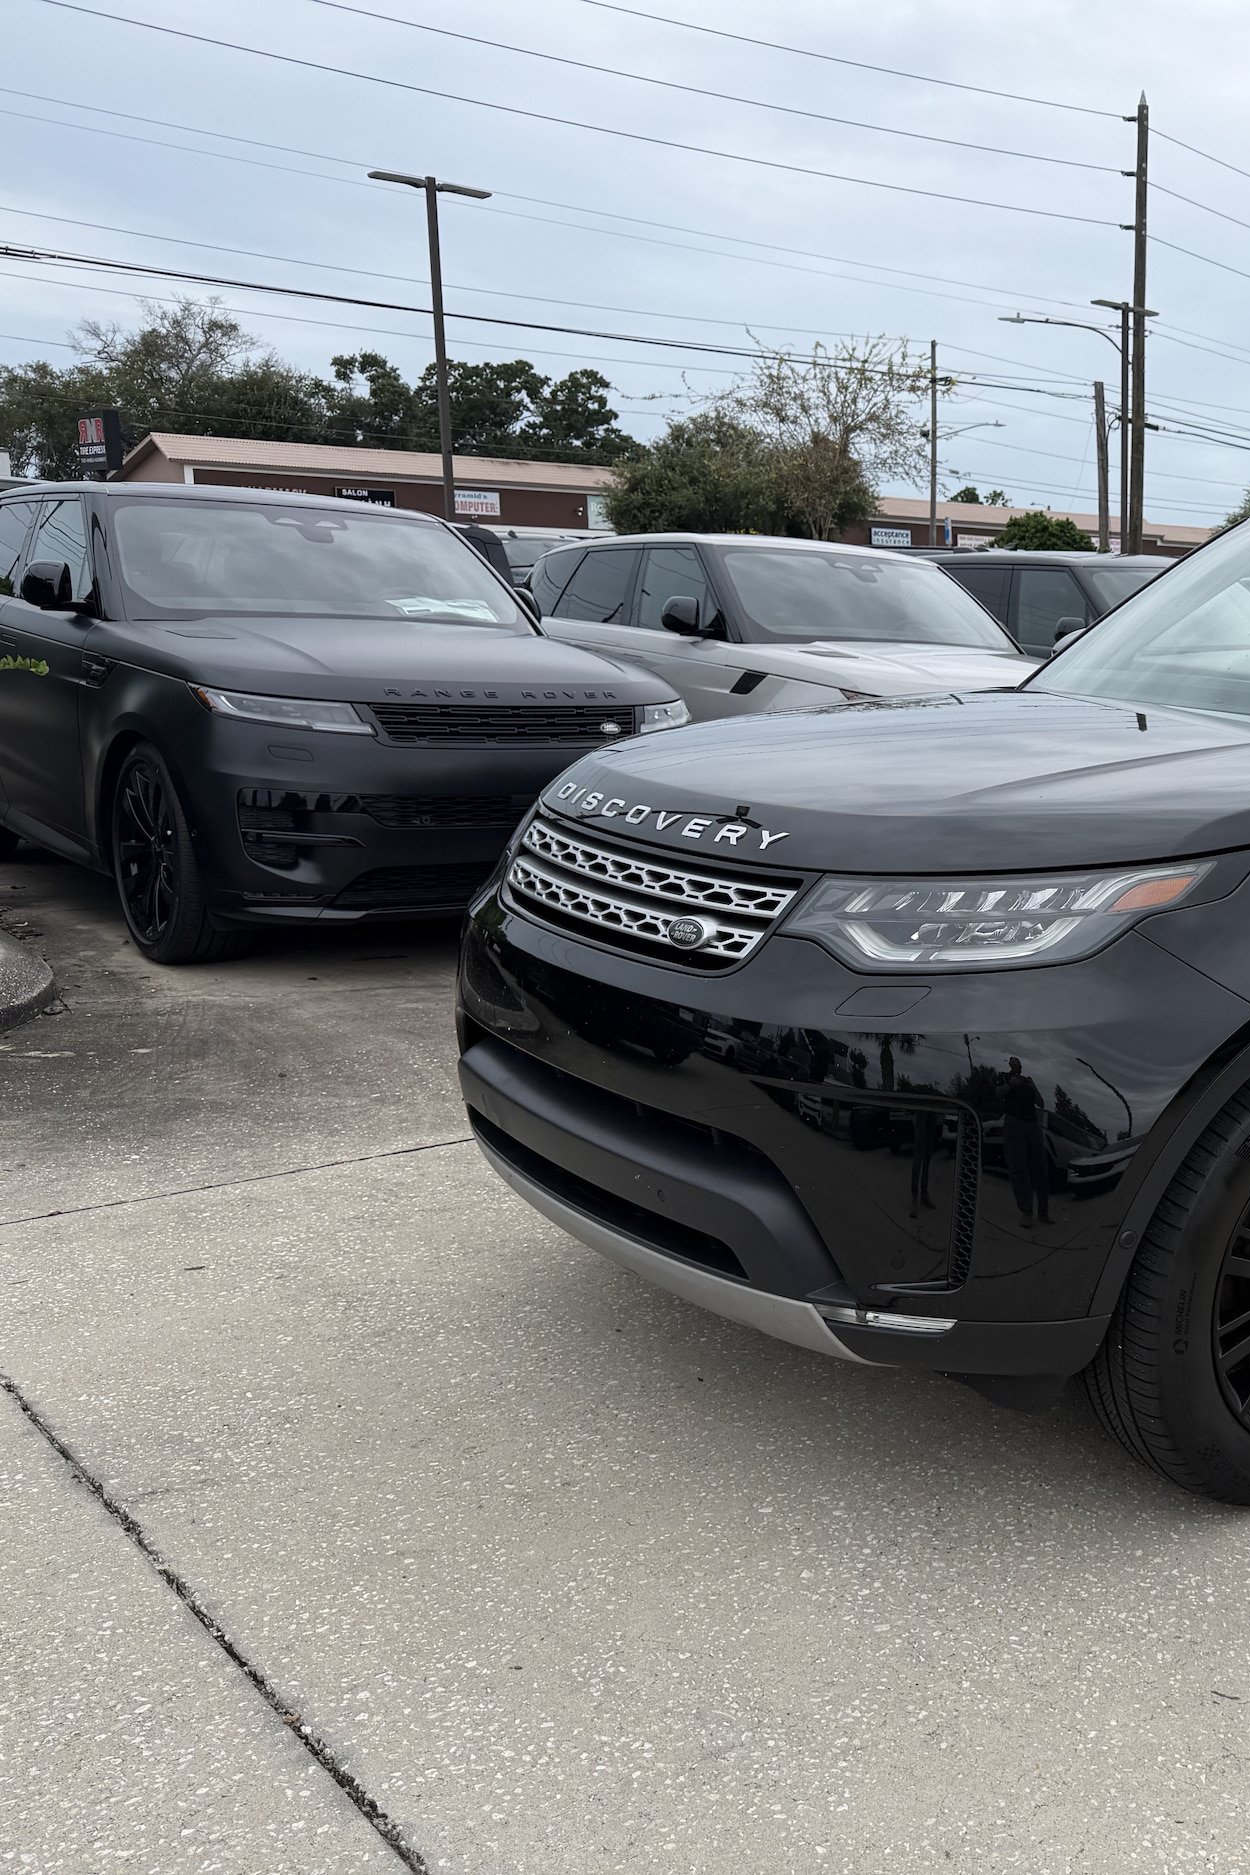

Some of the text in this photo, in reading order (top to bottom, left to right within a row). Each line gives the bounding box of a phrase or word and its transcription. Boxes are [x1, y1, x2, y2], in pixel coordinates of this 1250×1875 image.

[80, 446, 89, 455] TIRE
[455, 501, 496, 512] OMPUTER
[873, 531, 909, 539] acceptance
[383, 688, 618, 699] RANGE ROVER
[557, 782, 790, 850] DISCOVERY
[675, 922, 694, 933] LAND
[673, 931, 697, 942] ROVER
[1175, 1289, 1187, 1335] MICHELIN
